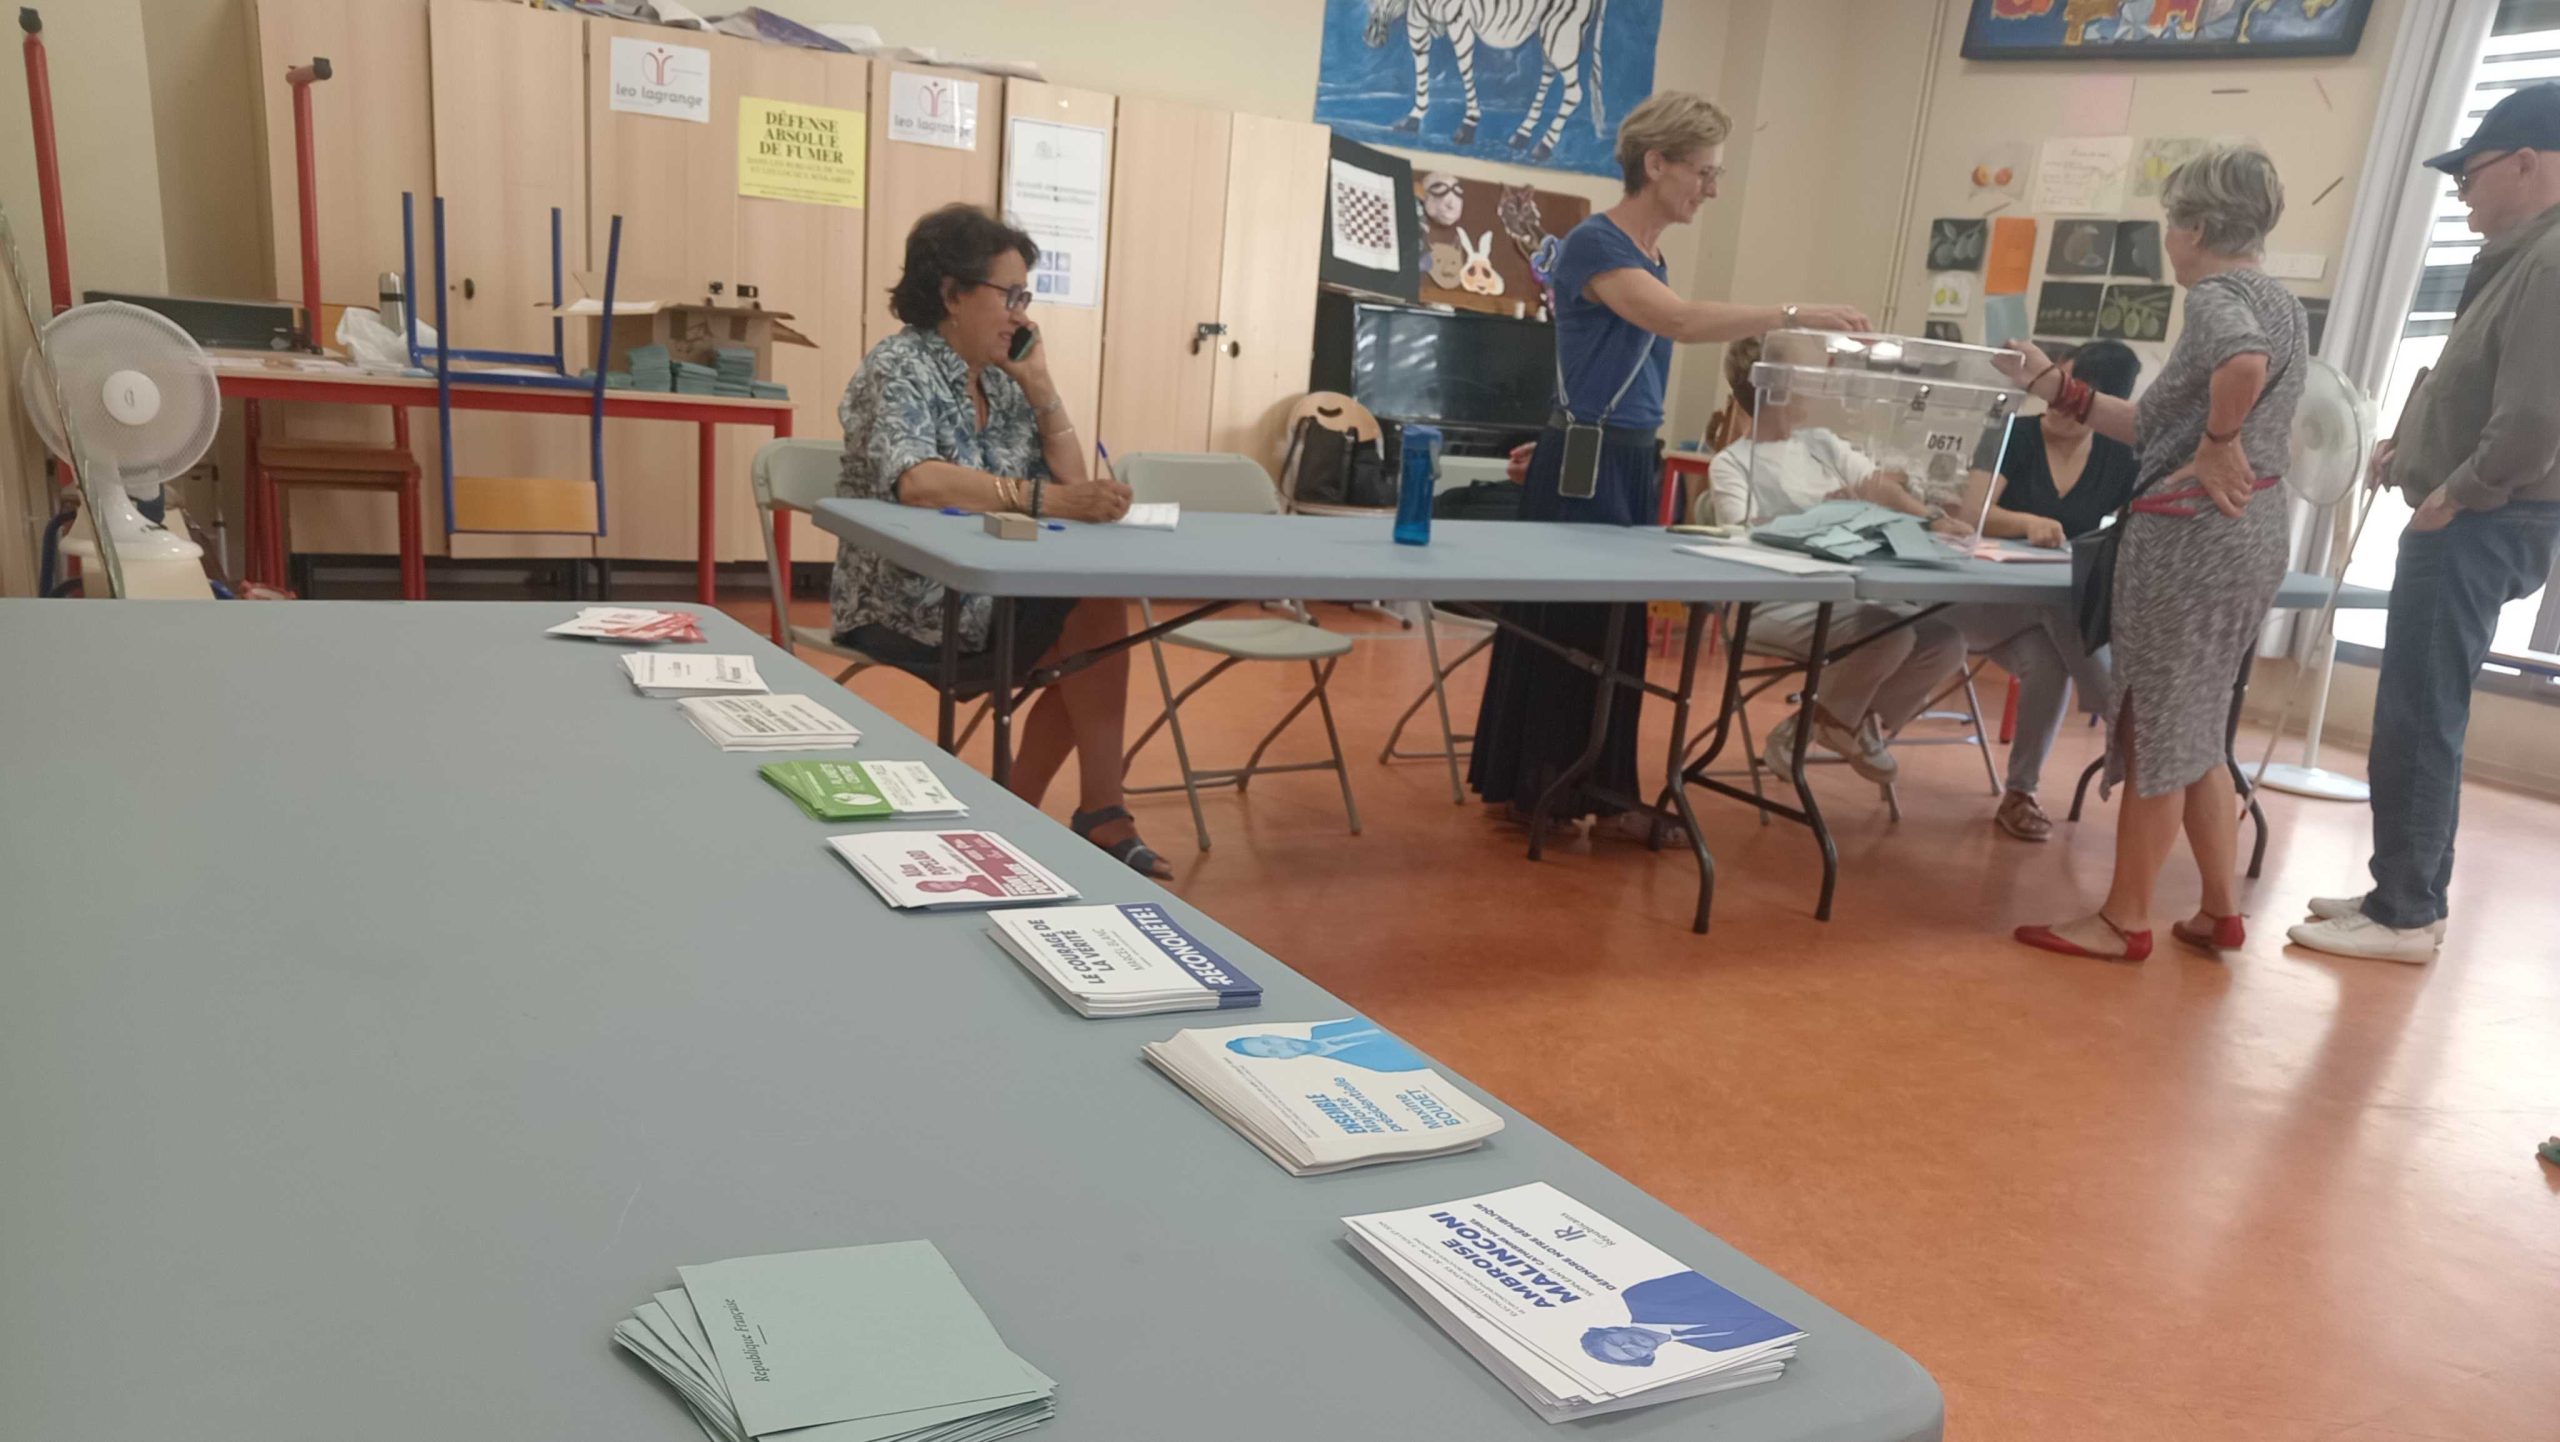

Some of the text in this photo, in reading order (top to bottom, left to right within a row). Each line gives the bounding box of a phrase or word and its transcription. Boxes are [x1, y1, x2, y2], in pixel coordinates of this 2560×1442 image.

[615, 81, 702, 108] leo lagrange
[766, 110, 838, 133] DÉFENSE
[894, 114, 913, 127] leo
[760, 142, 843, 164] DE FUMER
[764, 127, 838, 148] ABSOLUE
[1928, 434, 1962, 451] 0671
[1026, 919, 1106, 983] LE COURAGE DE
[1057, 929, 1100, 957] VÉRITÉ
[1090, 960, 1116, 971] LA
[1305, 1093, 1368, 1134] ENSEMBLE
[1394, 1094, 1443, 1129] Maxime
[1404, 1088, 1462, 1126] BOUDET
[1429, 1211, 1582, 1303] MALINCONI
[1470, 1202, 1617, 1291] DÉFENDRE NOTRE RÉPUBLIQUE
[1441, 1238, 1557, 1307] AMBROISE
[723, 1298, 770, 1382] République Française
